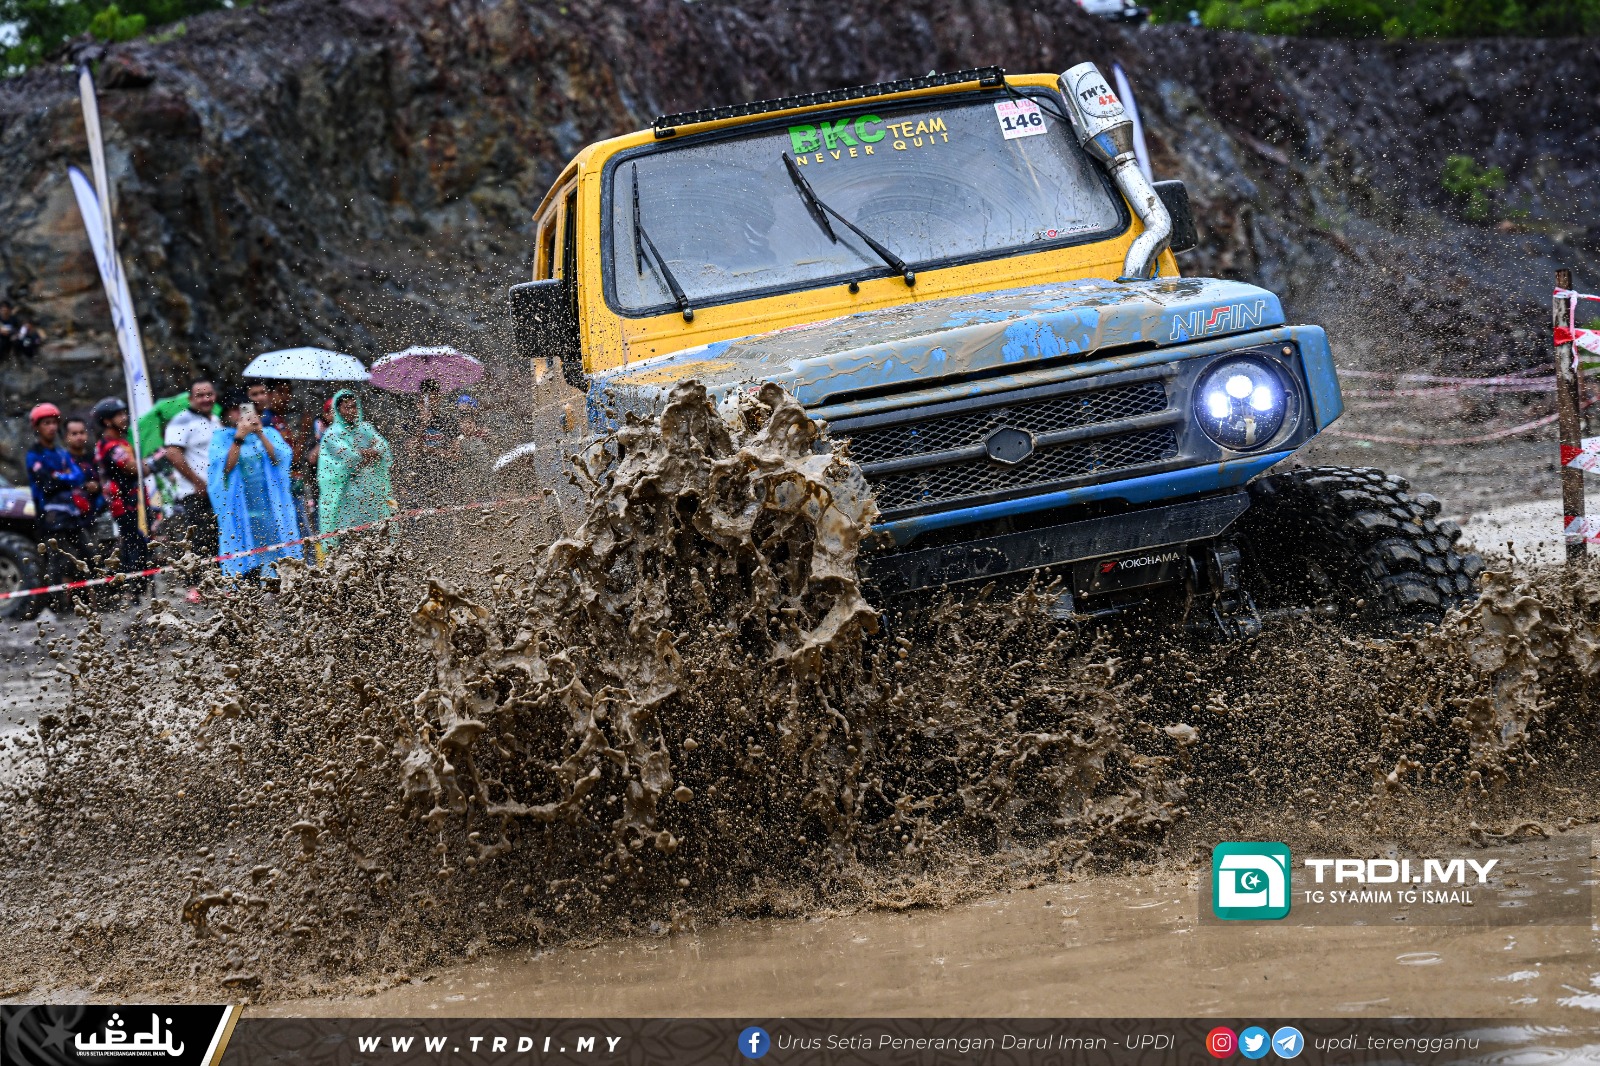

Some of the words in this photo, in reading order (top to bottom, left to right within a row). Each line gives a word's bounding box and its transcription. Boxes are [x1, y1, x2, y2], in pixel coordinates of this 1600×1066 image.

[788, 114, 886, 155] BKC
[887, 117, 947, 139] TEAM
[1002, 112, 1042, 131] 146
[796, 145, 875, 166] NEVER
[893, 132, 949, 151] QUIT
[1169, 300, 1266, 341] NISSIN
[1119, 552, 1180, 570] YOKOHAMA
